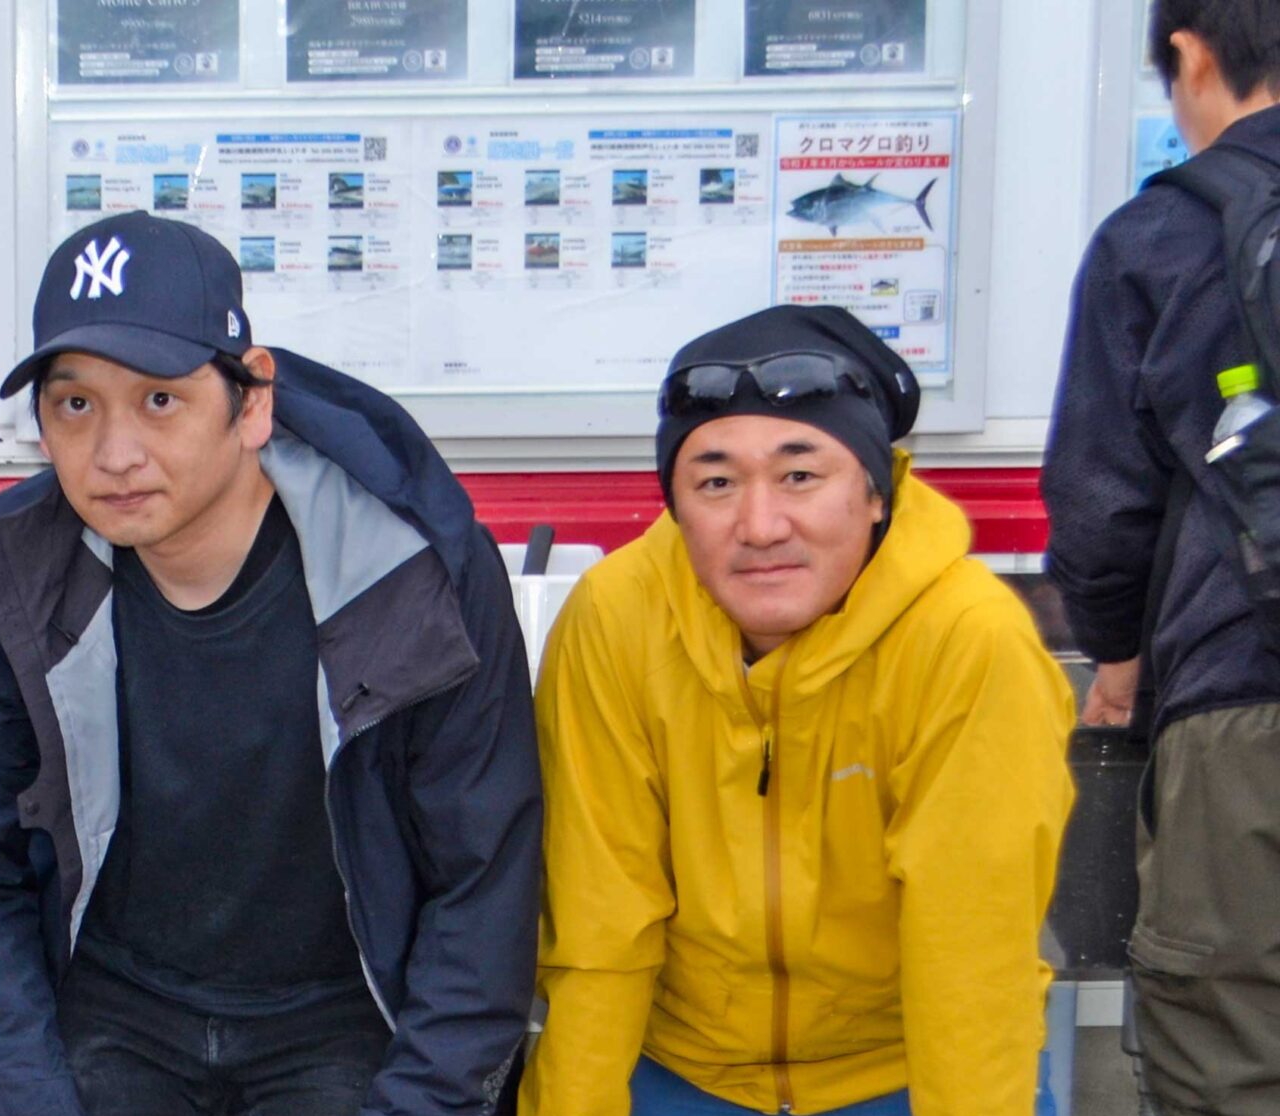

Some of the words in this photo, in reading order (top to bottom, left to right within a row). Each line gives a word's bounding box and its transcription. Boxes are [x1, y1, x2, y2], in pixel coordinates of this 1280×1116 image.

[799, 134, 930, 154] クロマグロ釣り
[69, 235, 131, 301] NY
